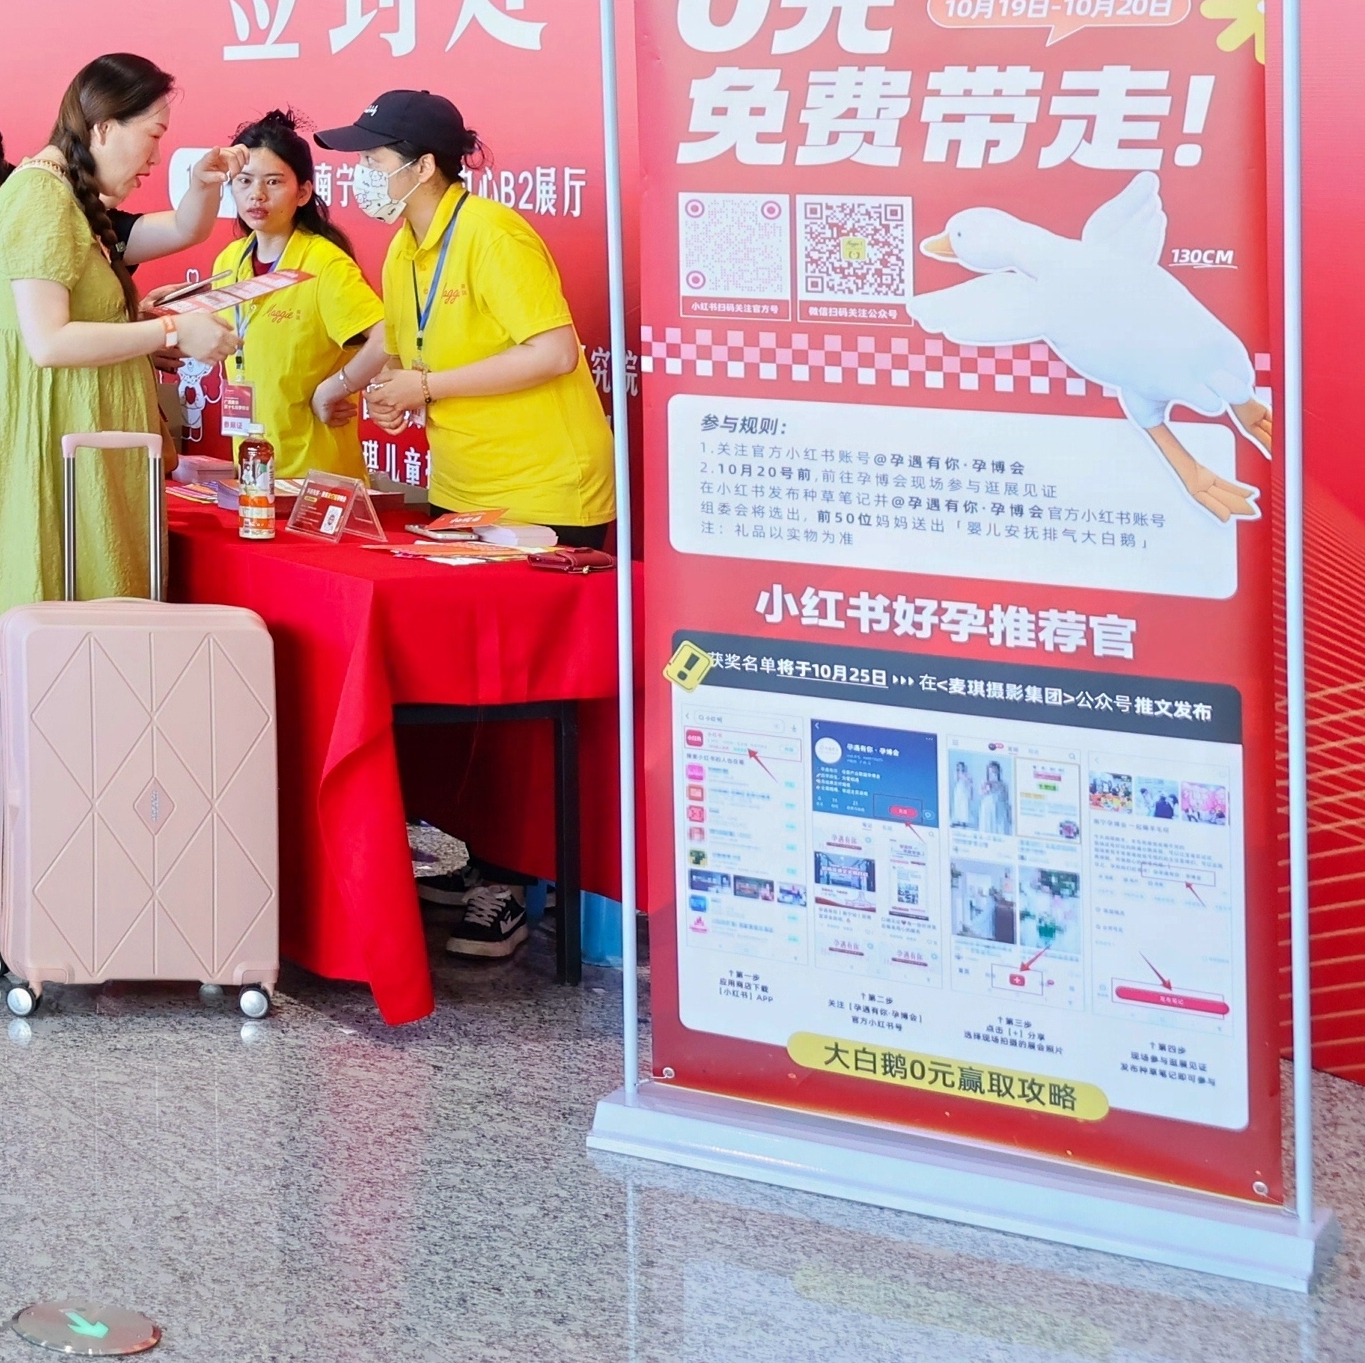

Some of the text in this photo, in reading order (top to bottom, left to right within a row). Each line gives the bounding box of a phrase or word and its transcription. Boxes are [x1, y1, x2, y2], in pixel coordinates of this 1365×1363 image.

[1171, 249, 1234, 264] 130CM
[755, 584, 1137, 659] 小红书好孕推荐官
[823, 1042, 1077, 1111] 大白鹅0元赢取攻略
